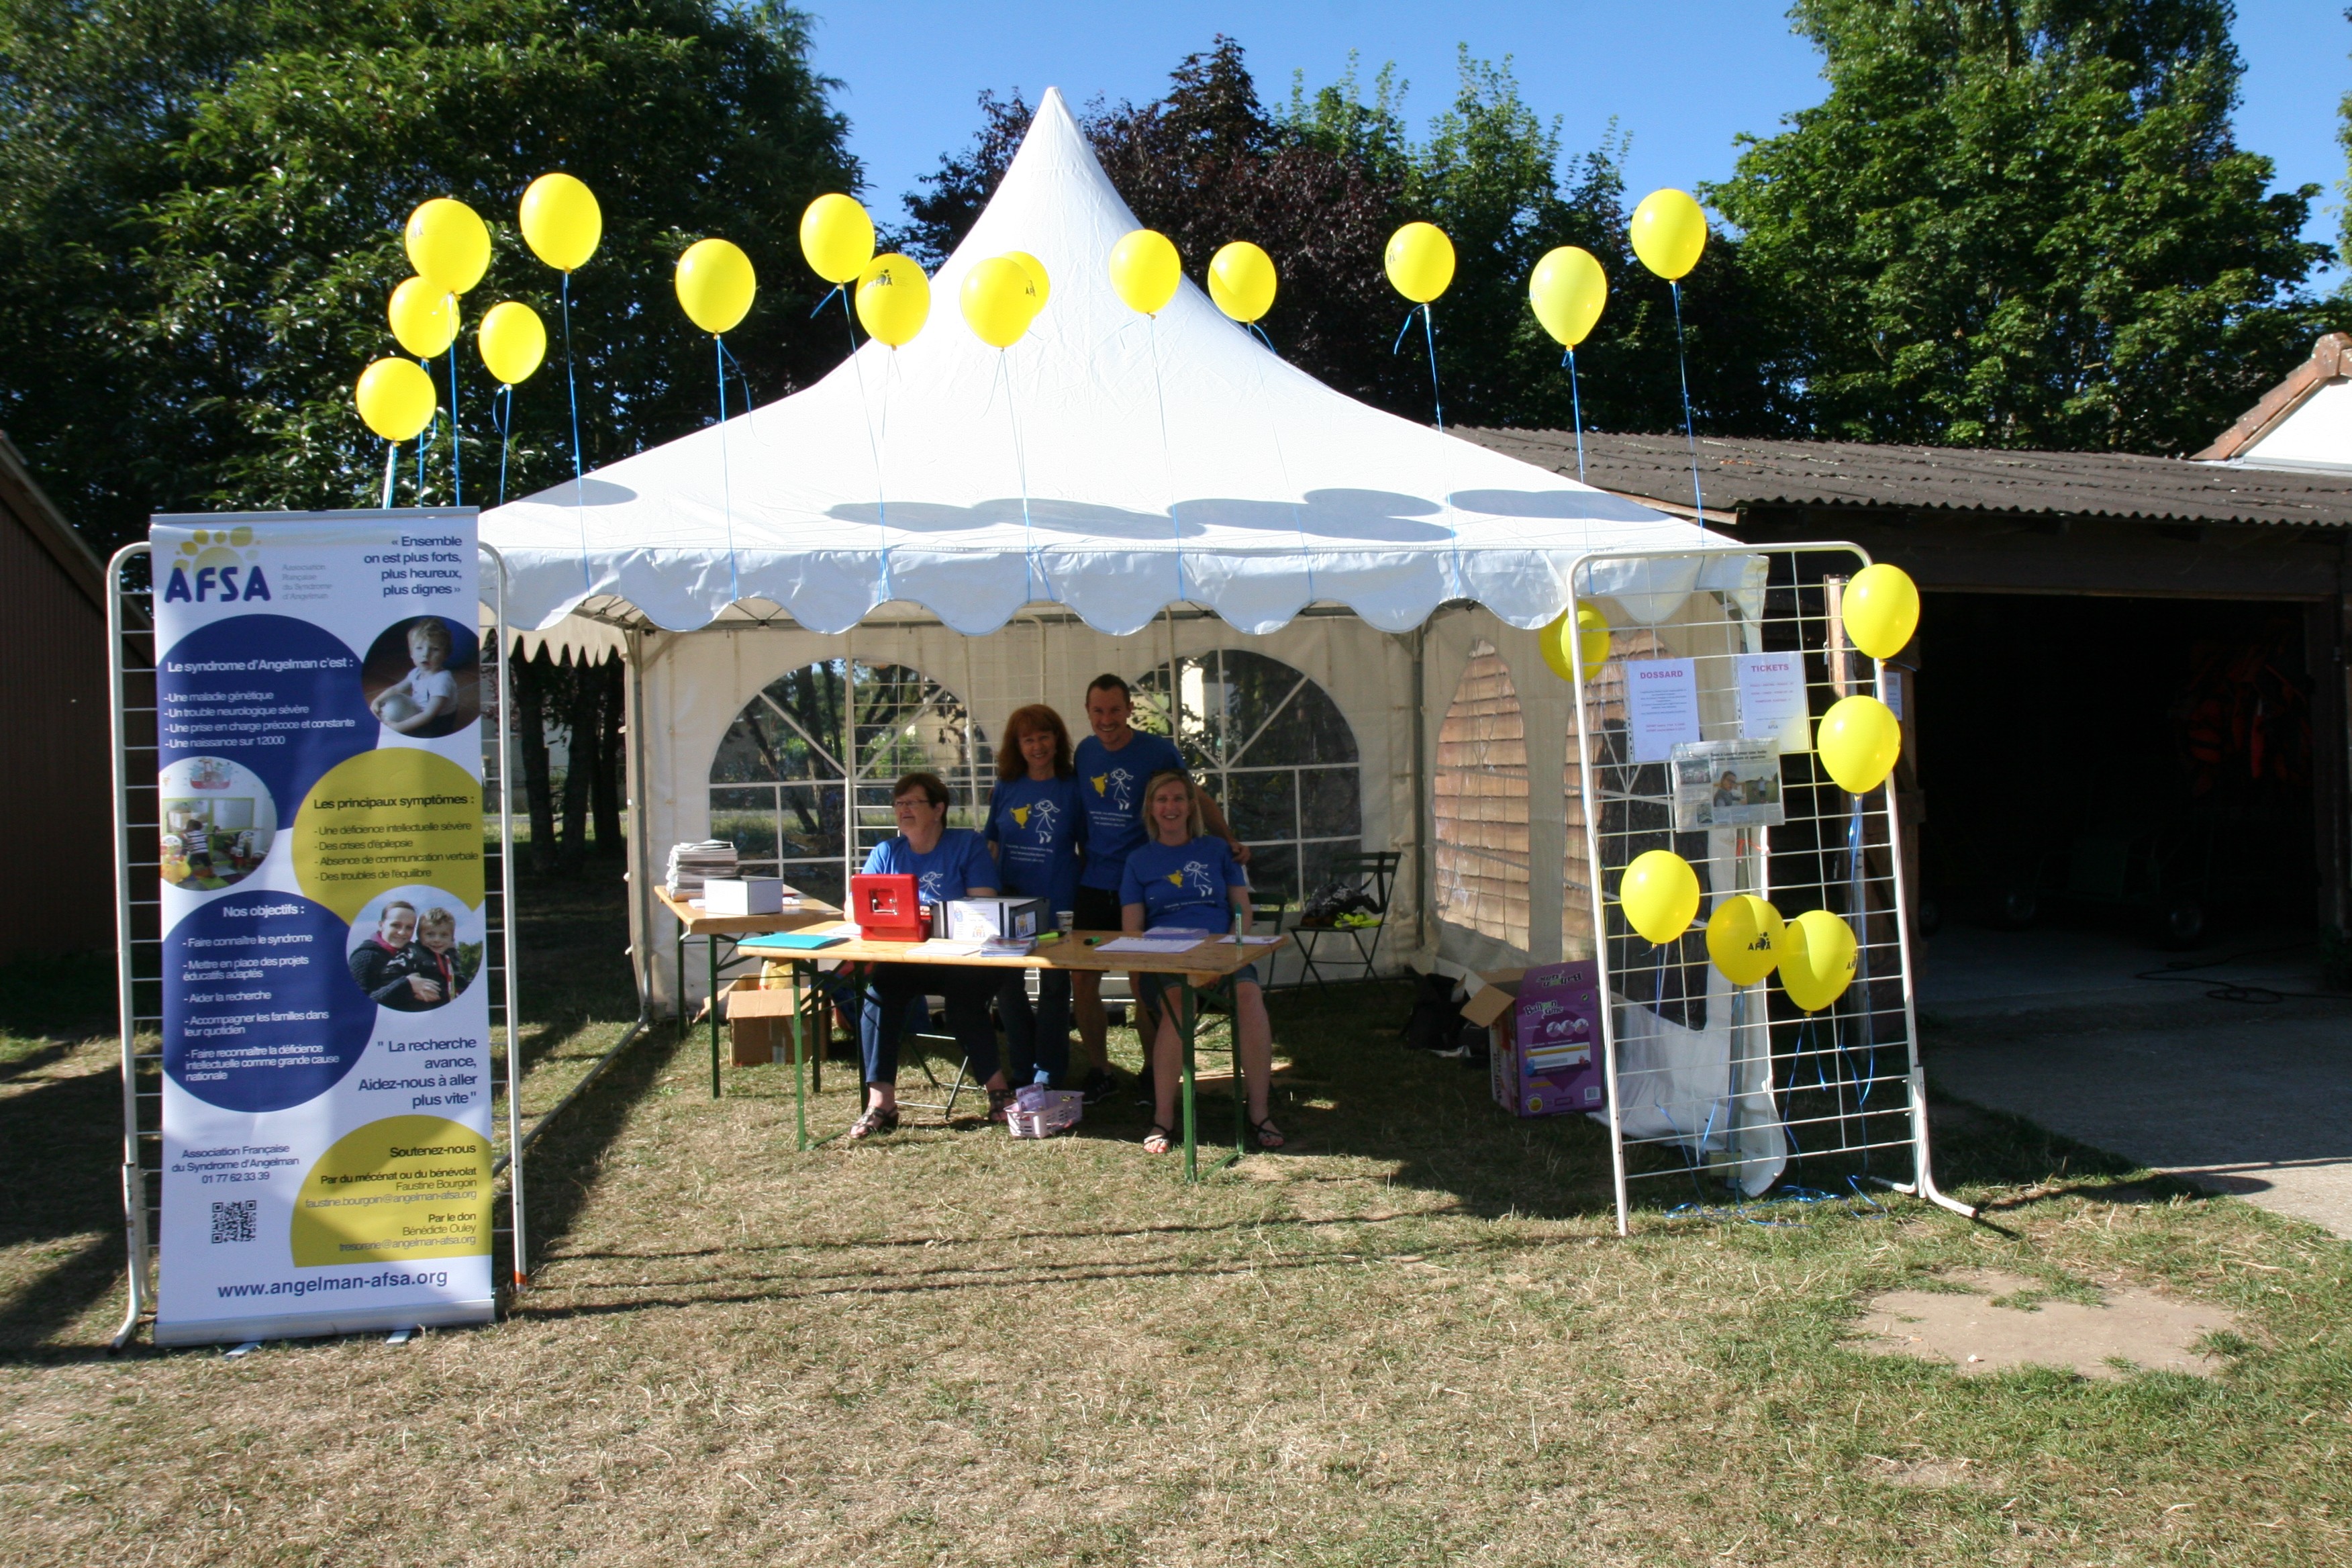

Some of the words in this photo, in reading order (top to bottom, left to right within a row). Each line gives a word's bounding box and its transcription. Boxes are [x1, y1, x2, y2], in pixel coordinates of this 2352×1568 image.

[401, 536, 462, 546] Ensemble
[364, 554, 380, 564] on
[383, 553, 401, 563] est
[403, 552, 428, 565] plus
[431, 551, 462, 564] forts,
[381, 569, 407, 582] plus
[410, 568, 462, 579] heureux,
[164, 565, 272, 603] AFSA
[383, 585, 408, 597] plus
[411, 583, 452, 597] dignes
[168, 661, 183, 672] Le
[184, 660, 246, 674] syndrome
[247, 658, 317, 672] d'Angelman
[320, 657, 347, 669] c'est
[1751, 663, 1790, 672] TICKETS
[1640, 670, 1683, 679] DOSSARD
[189, 691, 226, 701] maladie
[228, 691, 274, 703] génétique
[183, 707, 215, 717] trouble
[217, 706, 277, 718] neurologique
[278, 705, 309, 714] sévère
[190, 723, 213, 734] prise
[214, 724, 228, 732] en
[228, 721, 261, 733] charge
[262, 720, 299, 732] précoce
[301, 720, 310, 728] et
[311, 718, 355, 729] constante
[190, 738, 238, 748] naissance
[239, 738, 255, 746] sur
[314, 799, 335, 810] Les
[338, 797, 397, 811] principaux
[400, 794, 468, 809] symptômes
[319, 826, 338, 836] Une
[340, 824, 385, 834] déficience
[387, 822, 439, 833] intellectuelle
[441, 822, 472, 832] sévère
[320, 842, 338, 851] Des
[339, 841, 366, 850] crises
[367, 839, 413, 850] d'épilepsie
[320, 856, 360, 866] Absence
[362, 855, 374, 865] de
[376, 853, 443, 863] communication
[446, 852, 478, 861] verbale
[320, 873, 339, 881] Des
[340, 871, 377, 881] troubles
[378, 871, 390, 879] de
[223, 906, 248, 918] Nos
[250, 904, 299, 918] objectifs
[188, 937, 212, 948] Faire
[214, 936, 256, 946] connaître
[258, 934, 266, 944] le
[267, 933, 313, 946] syndrome
[189, 960, 219, 970] Mettre
[219, 961, 233, 969] en
[234, 958, 259, 969] place
[260, 957, 278, 967] des
[279, 955, 309, 967] projets
[183, 970, 224, 981] éducatifs
[226, 969, 264, 981] adaptés
[189, 993, 214, 1003] Aider
[215, 992, 224, 1002] la
[225, 991, 271, 1001] recherche
[189, 1014, 254, 1026] Accompagner
[256, 1013, 270, 1022] les
[271, 1012, 305, 1021] familles
[305, 1010, 330, 1020] dans
[184, 1027, 202, 1037] leur
[203, 1026, 246, 1038] quotidien
[191, 1049, 214, 1059] Faire
[216, 1046, 267, 1059] reconnaître
[268, 1045, 277, 1055] la
[278, 1044, 323, 1055] déficience
[389, 1041, 405, 1052] La
[408, 1038, 477, 1052] recherche
[185, 1059, 240, 1070] intellectuelle
[242, 1058, 277, 1068] comme
[278, 1055, 310, 1068] grande
[311, 1055, 340, 1065] cause
[424, 1057, 477, 1069] avance,
[185, 1071, 228, 1082] nationale
[358, 1077, 436, 1091] Aidez-nous
[438, 1075, 447, 1087] à
[449, 1073, 478, 1086] aller
[412, 1094, 442, 1109] plus
[444, 1092, 469, 1104] vite
[181, 1146, 240, 1159] Association
[242, 1144, 291, 1157] Française
[390, 1144, 477, 1159] Soutenez-nous
[171, 1163, 185, 1173] du
[187, 1161, 239, 1173] Syndrome
[241, 1157, 299, 1169] d'Angelman
[202, 1175, 213, 1184] 01
[216, 1174, 228, 1183] 77
[230, 1173, 242, 1182] 62
[244, 1172, 256, 1181] 33
[258, 1171, 270, 1181] 39
[321, 1175, 338, 1185] Par
[340, 1174, 354, 1183] du
[355, 1171, 398, 1183] mécénat
[399, 1172, 412, 1180] ou
[413, 1169, 428, 1179] du
[429, 1167, 477, 1178] bénévolat
[396, 1181, 435, 1191] Faustine
[436, 1179, 477, 1191] Bourgoin
[305, 1189, 477, 1208] faustine.bourgoin@angelman-afsa.org
[428, 1214, 445, 1223] Par
[447, 1213, 456, 1222] le
[457, 1212, 477, 1222] don
[402, 1224, 448, 1236] Bénédicte
[217, 1269, 448, 1297] www.angelman-afsa.org
